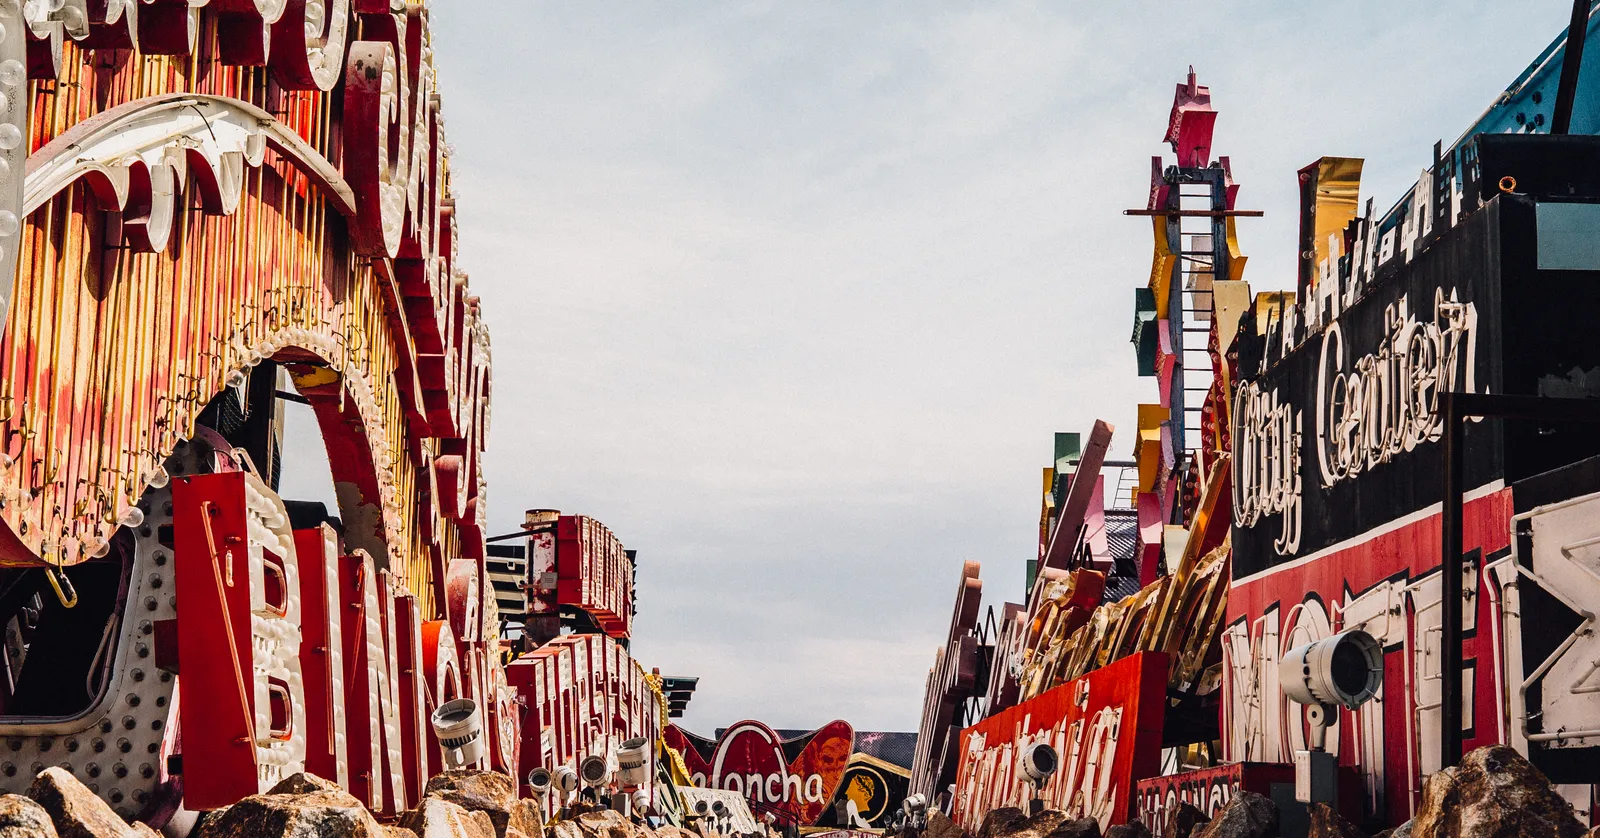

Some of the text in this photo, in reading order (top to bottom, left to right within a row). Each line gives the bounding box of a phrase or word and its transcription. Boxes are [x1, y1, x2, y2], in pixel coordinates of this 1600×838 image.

[1231, 379, 1303, 556] City
[1220, 556, 1529, 824] MOTEL
[1137, 774, 1240, 837] VACNCY
